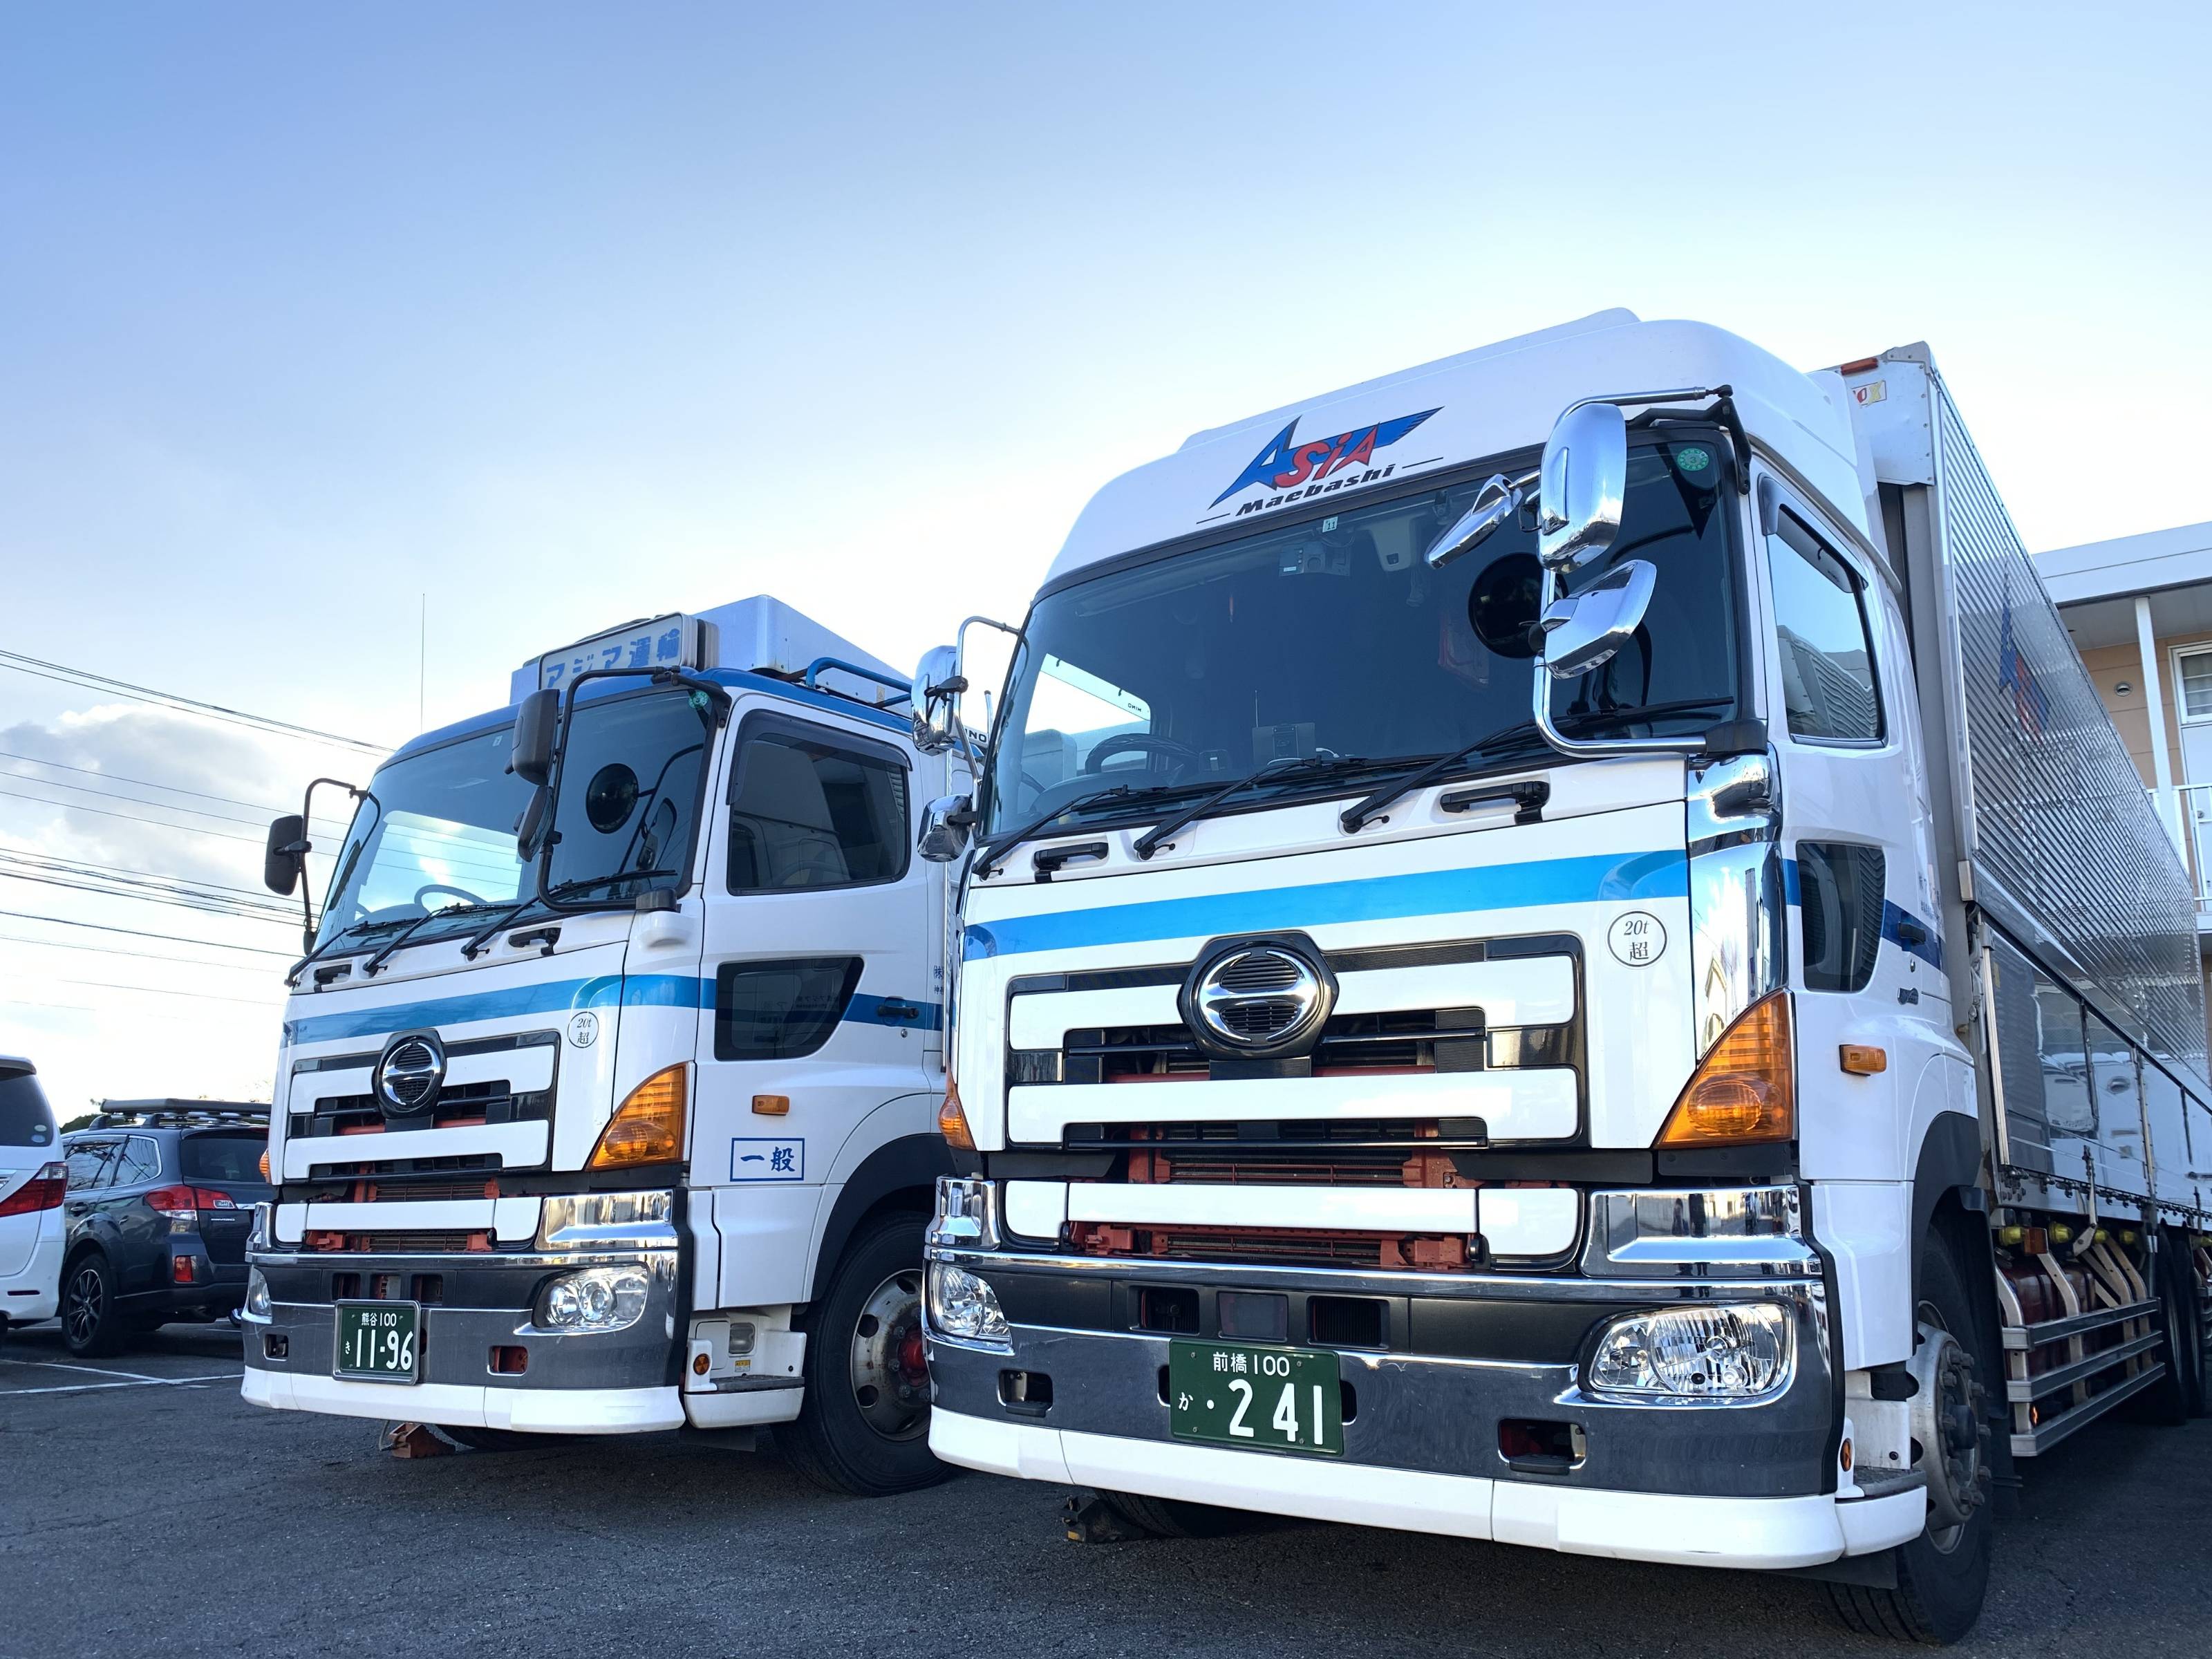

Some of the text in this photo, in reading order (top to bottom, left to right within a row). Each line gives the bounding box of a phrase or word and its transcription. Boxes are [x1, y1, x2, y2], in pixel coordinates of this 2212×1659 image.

[1235, 463, 1396, 517] Maebashi
[545, 628, 681, 688] アジア運輸
[964, 728, 987, 743] INO
[1624, 919, 1650, 935] 20t
[1629, 941, 1650, 962] 超
[577, 1018, 592, 1028] 20t
[577, 1031, 590, 1044] 超
[740, 1146, 796, 1172] 一般
[356, 1329, 414, 1371] 11-96
[1178, 1391, 1194, 1411] か
